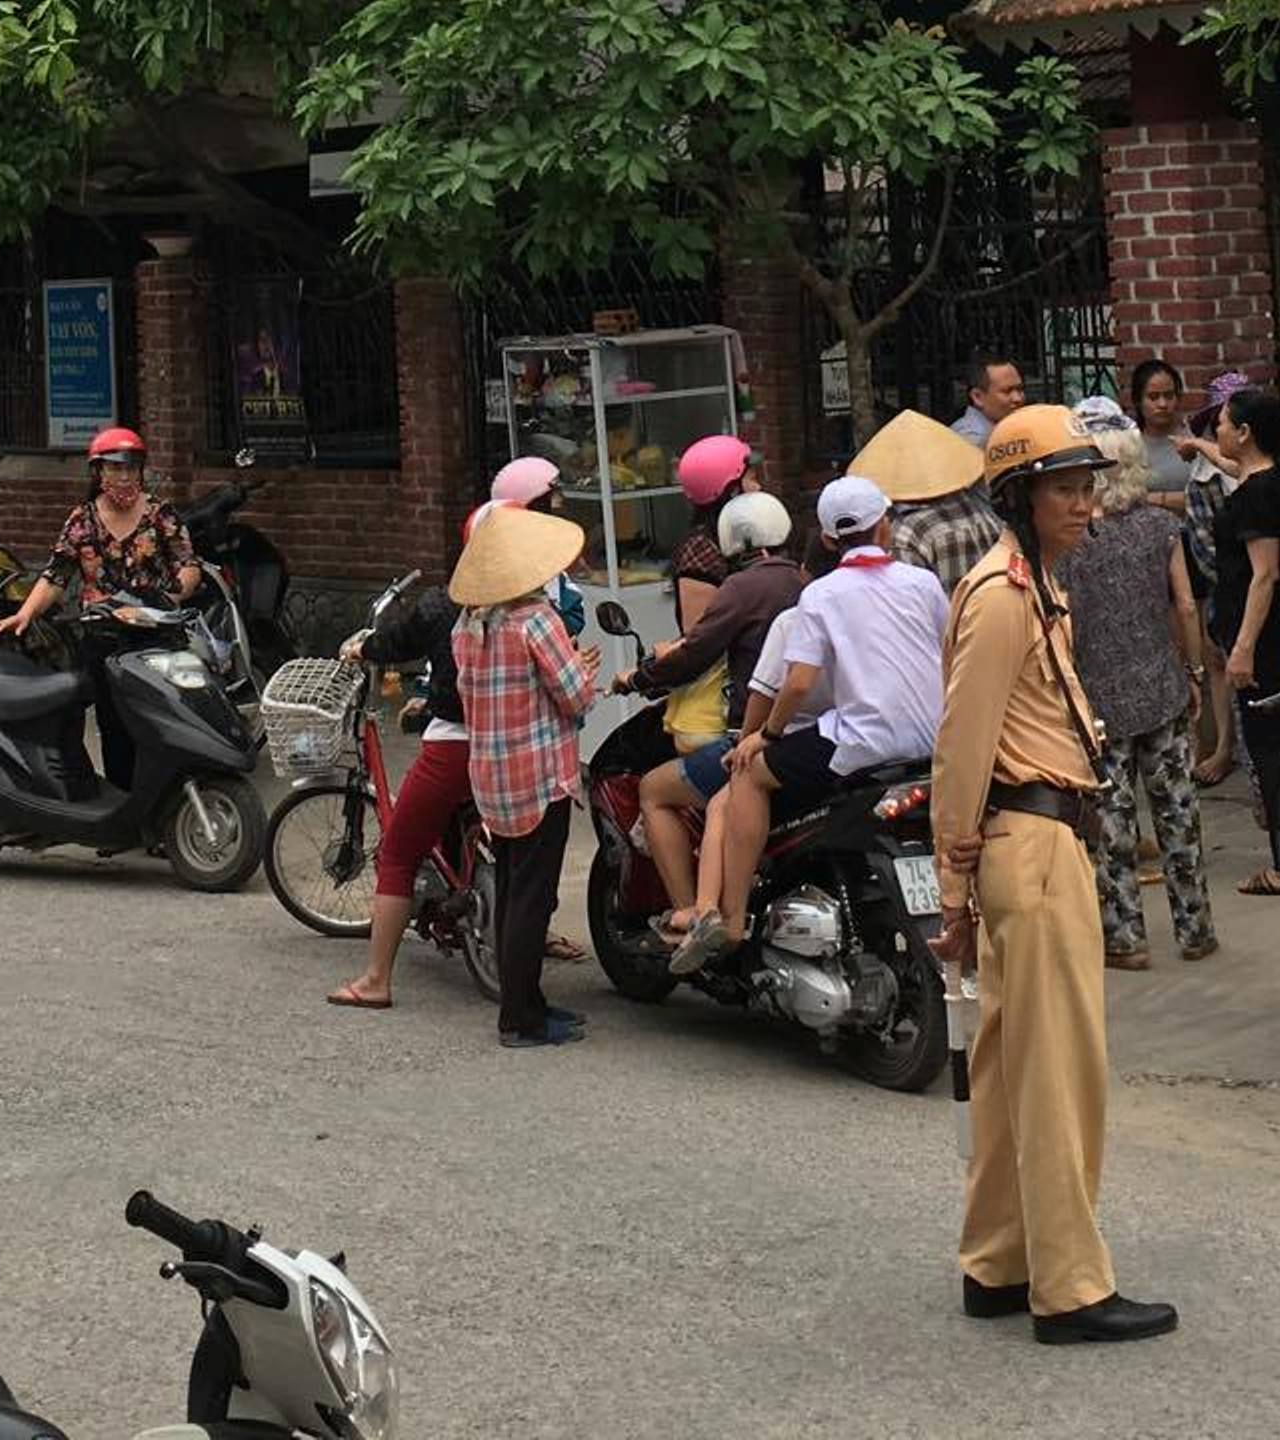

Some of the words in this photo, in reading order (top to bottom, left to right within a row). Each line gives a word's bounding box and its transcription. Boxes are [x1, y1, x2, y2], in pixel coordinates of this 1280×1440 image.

[990, 439, 1030, 461] CSGT
[905, 862, 932, 885] 74-
[907, 886, 942, 911] 236
